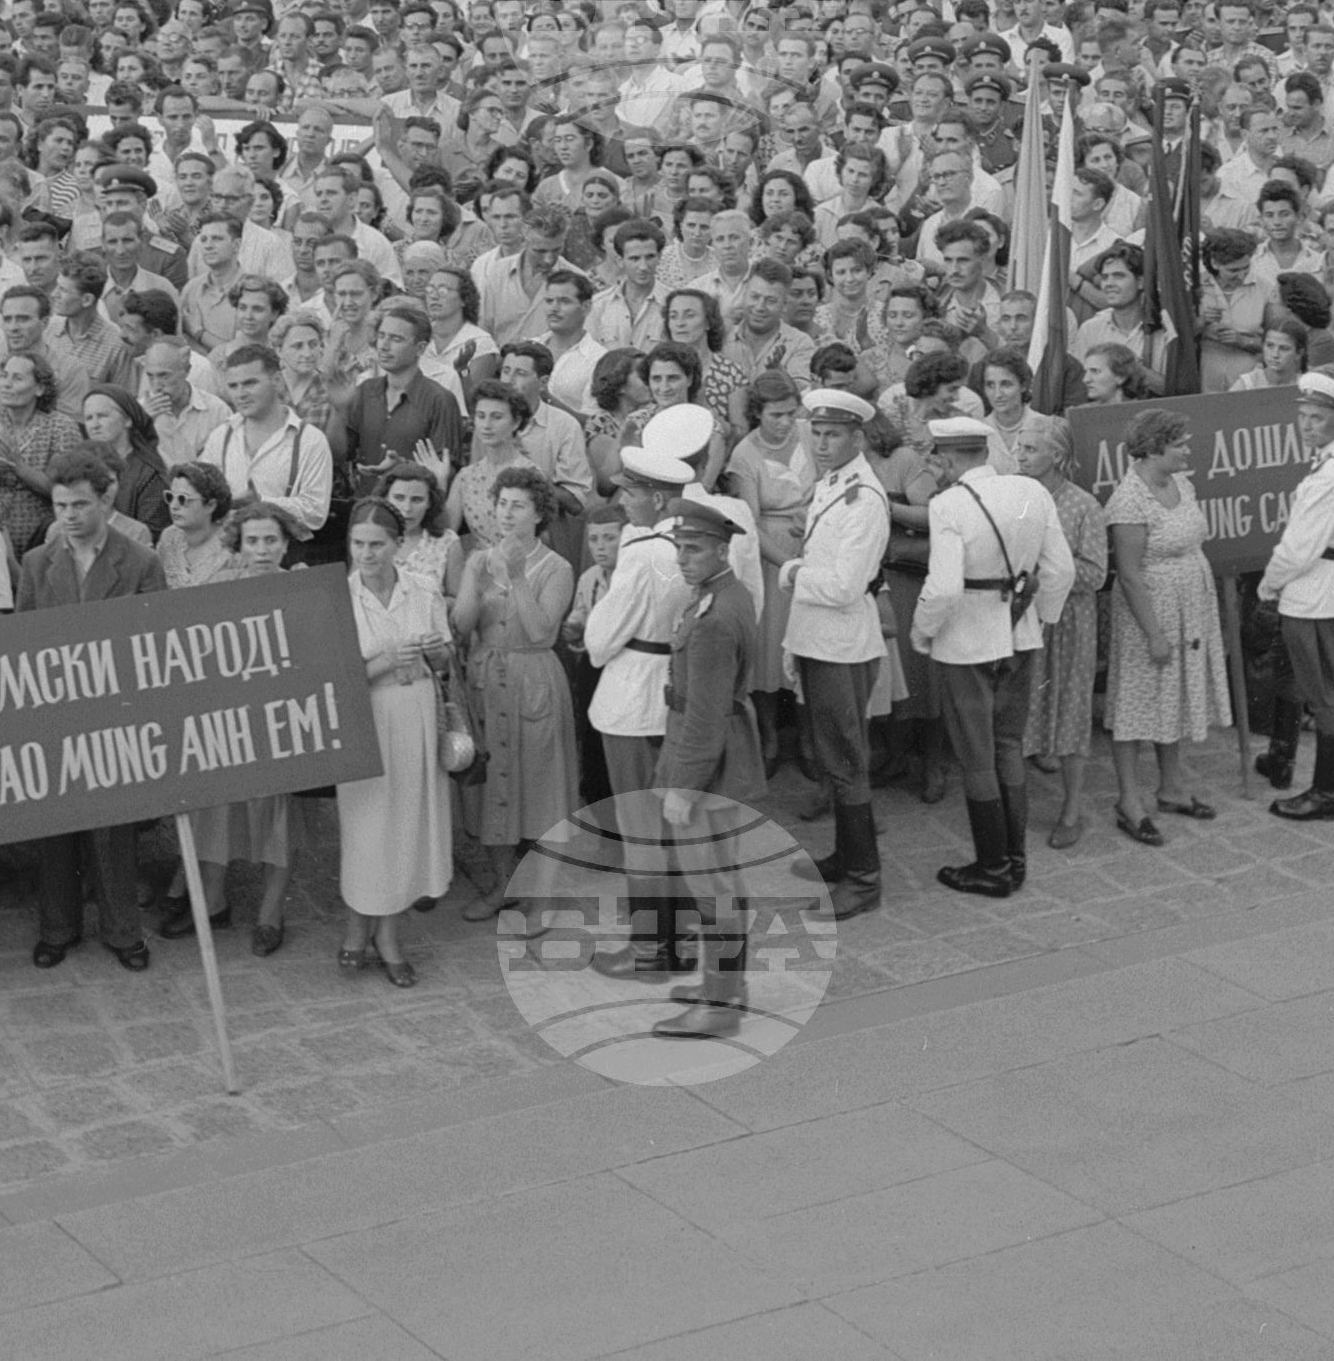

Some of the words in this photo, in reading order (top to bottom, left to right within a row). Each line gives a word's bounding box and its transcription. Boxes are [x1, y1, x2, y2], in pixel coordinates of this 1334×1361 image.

[129, 608, 292, 691] НАРОД!
[58, 721, 168, 796] MUNG
[179, 704, 258, 775] ANH
[264, 681, 342, 760] EM!
